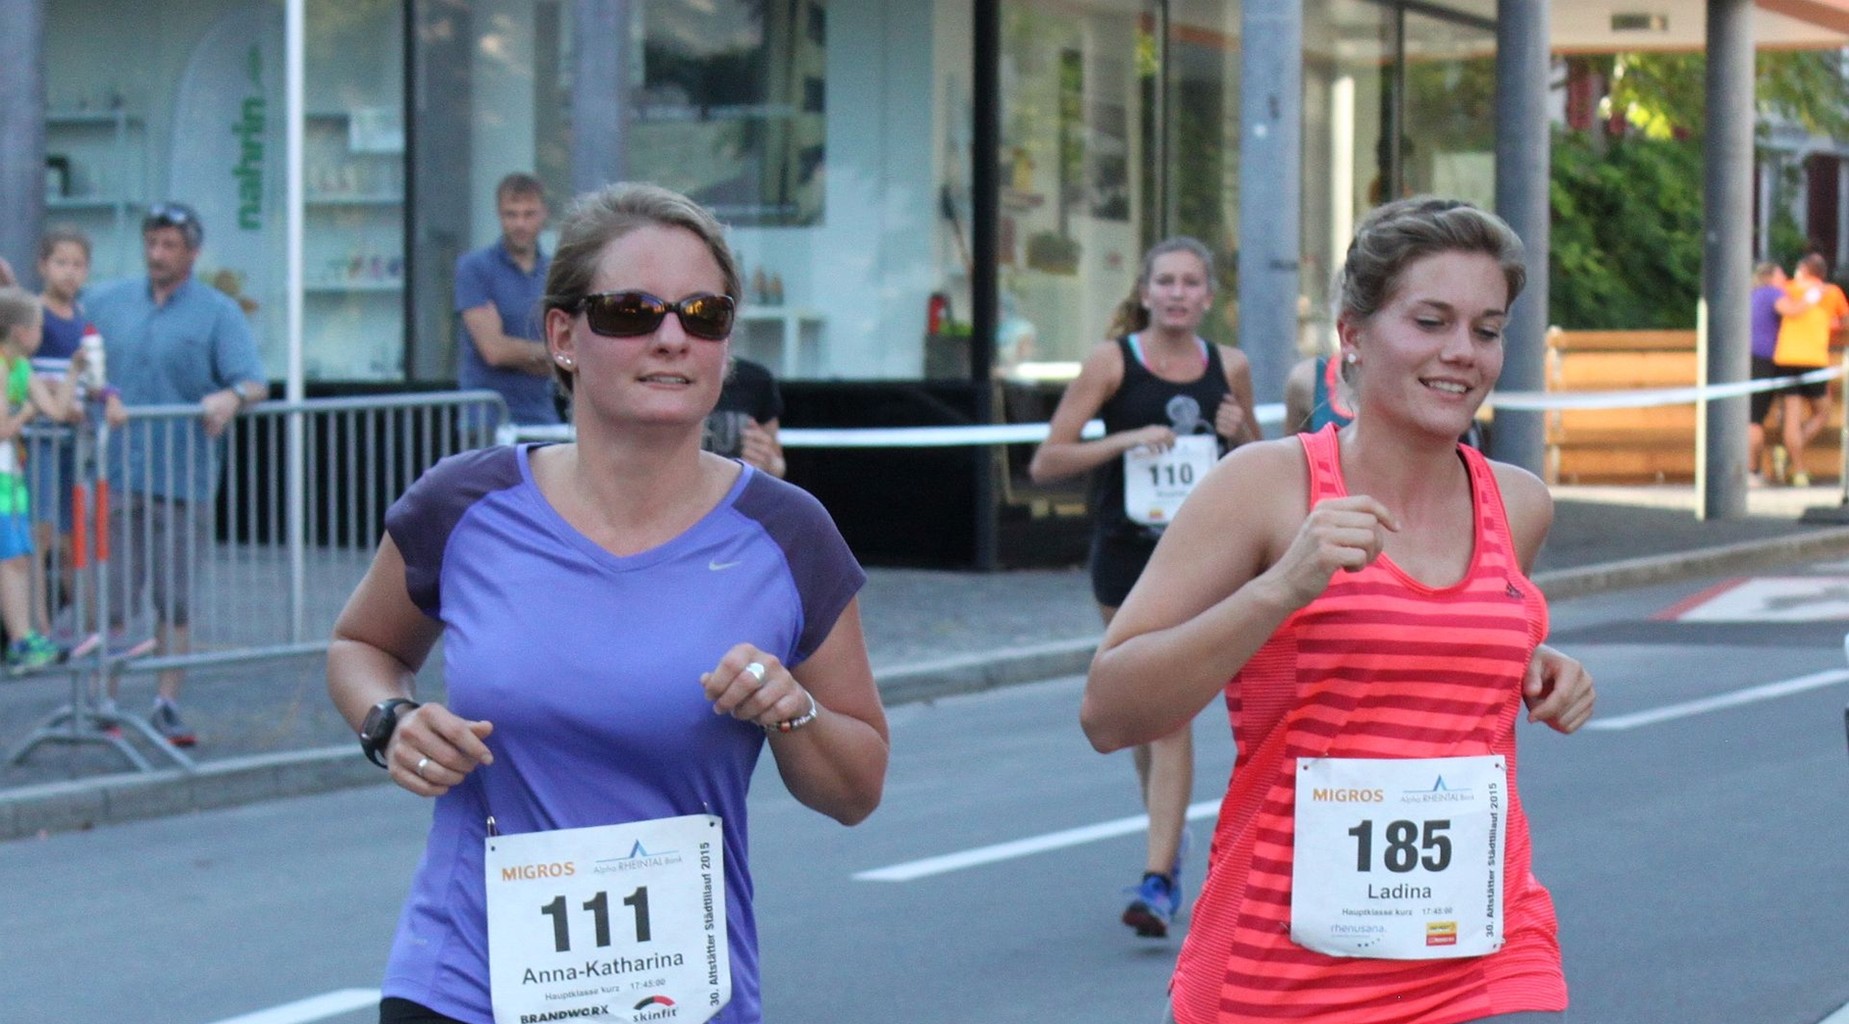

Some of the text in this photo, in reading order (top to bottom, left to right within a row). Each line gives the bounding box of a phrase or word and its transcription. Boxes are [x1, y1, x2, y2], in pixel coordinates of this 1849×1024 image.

[231, 98, 265, 230] nahrin
[1148, 462, 1194, 486] 110
[1312, 788, 1384, 803] MIGROS
[1488, 782, 1499, 809] 2015
[699, 841, 711, 870] 2015
[1348, 819, 1453, 874] 185
[501, 861, 576, 882] MIGROS
[1367, 883, 1433, 900] Ladina
[541, 885, 652, 953] 111
[1395, 907, 1413, 916] kurz
[1485, 921, 1495, 938] 30.
[522, 952, 684, 986] Anna-Katharina
[545, 987, 599, 1001] Hauptklasse
[600, 984, 620, 995] kurz
[709, 988, 720, 1007] 30.
[519, 1004, 609, 1024] BRANDWORX
[633, 1007, 677, 1023] skinfit
